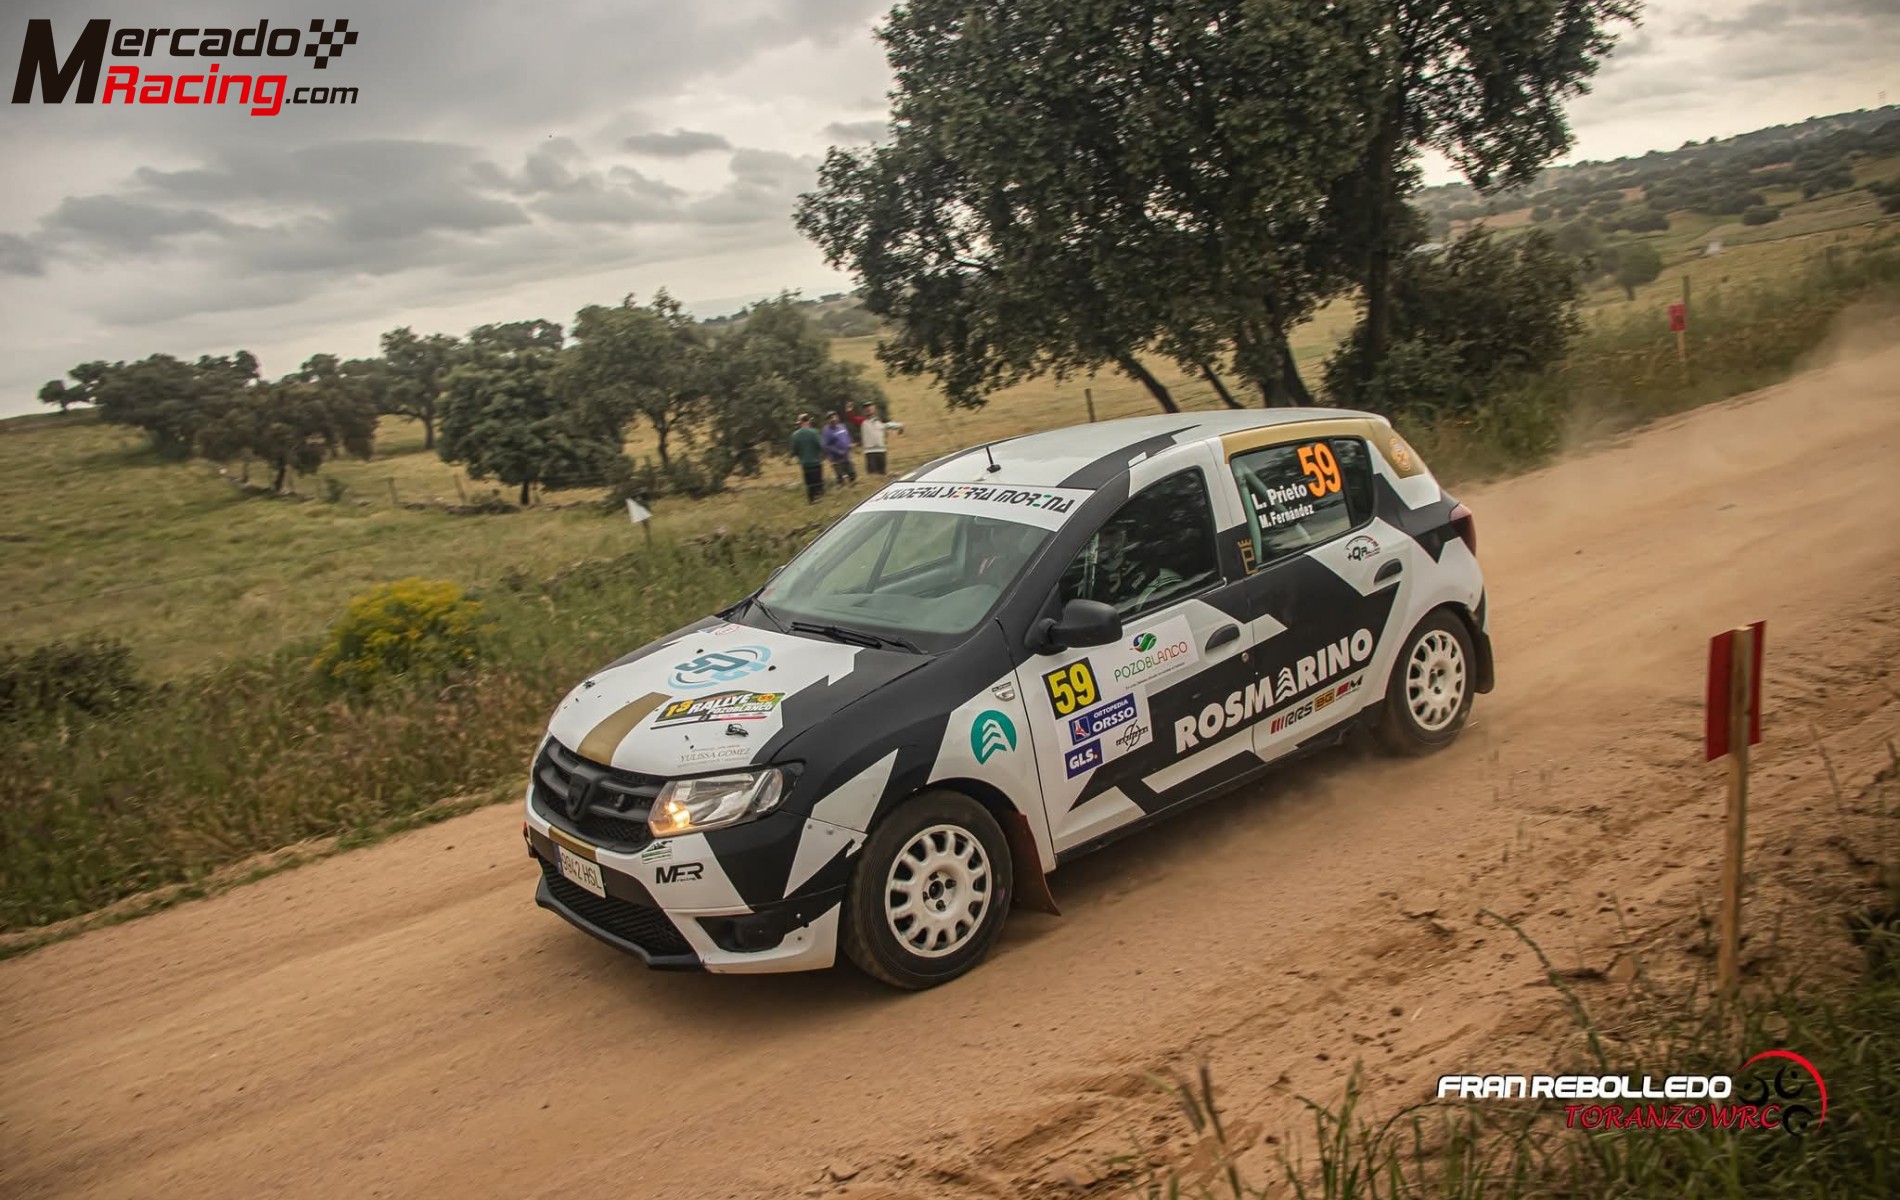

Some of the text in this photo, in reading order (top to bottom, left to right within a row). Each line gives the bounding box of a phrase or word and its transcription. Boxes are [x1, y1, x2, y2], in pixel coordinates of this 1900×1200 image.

[1297, 442, 1342, 498] 59
[1251, 482, 1308, 511] L. Prieto
[1259, 514, 1271, 529] M.
[1114, 641, 1188, 682] POZOBLANCO
[1048, 663, 1096, 715] 59
[1174, 628, 1373, 754] ROSMARINO
[687, 693, 754, 714] RALLYE
[1093, 699, 1129, 719] ORTOPEDIA
[1092, 706, 1135, 732] ORSSO
[656, 862, 704, 884] MFR
